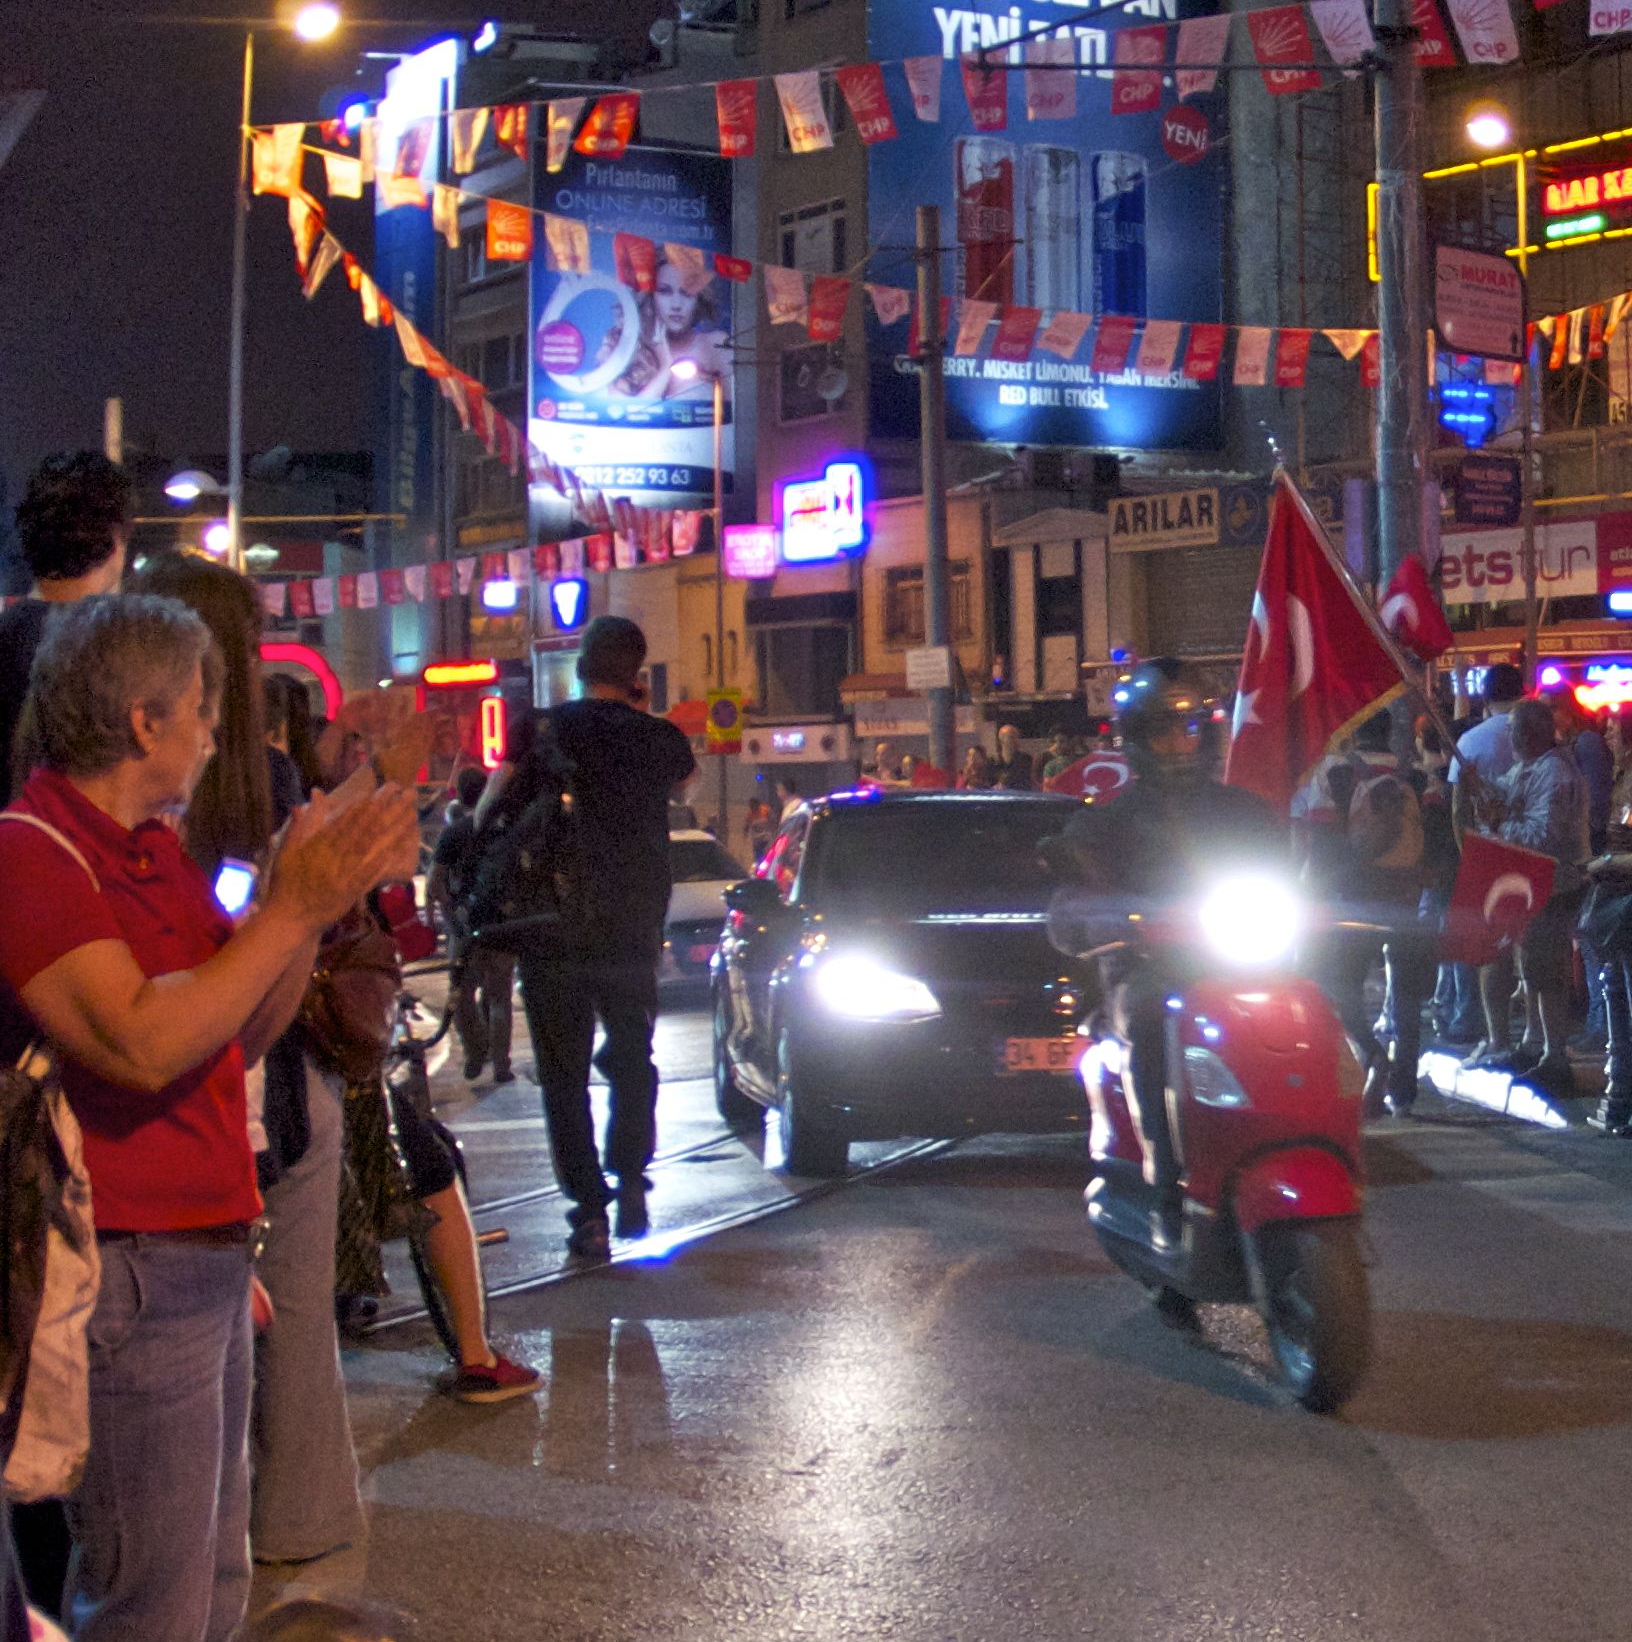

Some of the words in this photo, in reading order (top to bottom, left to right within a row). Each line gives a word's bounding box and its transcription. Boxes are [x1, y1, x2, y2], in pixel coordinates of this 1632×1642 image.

[1593, 7, 1632, 28] CHP
[933, 6, 1021, 65] YENİ
[1473, 40, 1507, 59] CHP
[1119, 82, 1154, 103] CHP
[791, 122, 826, 143] CHP
[857, 117, 890, 139] CHP
[1163, 120, 1208, 151] YENİ
[493, 241, 526, 254] CHP
[1460, 264, 1517, 290] MURAT
[999, 383, 1028, 406] RED
[1029, 385, 1061, 406] BULL
[616, 467, 645, 486] 252
[647, 468, 668, 486] 93
[670, 469, 691, 486] 63
[1111, 493, 1214, 536] ARILAR
